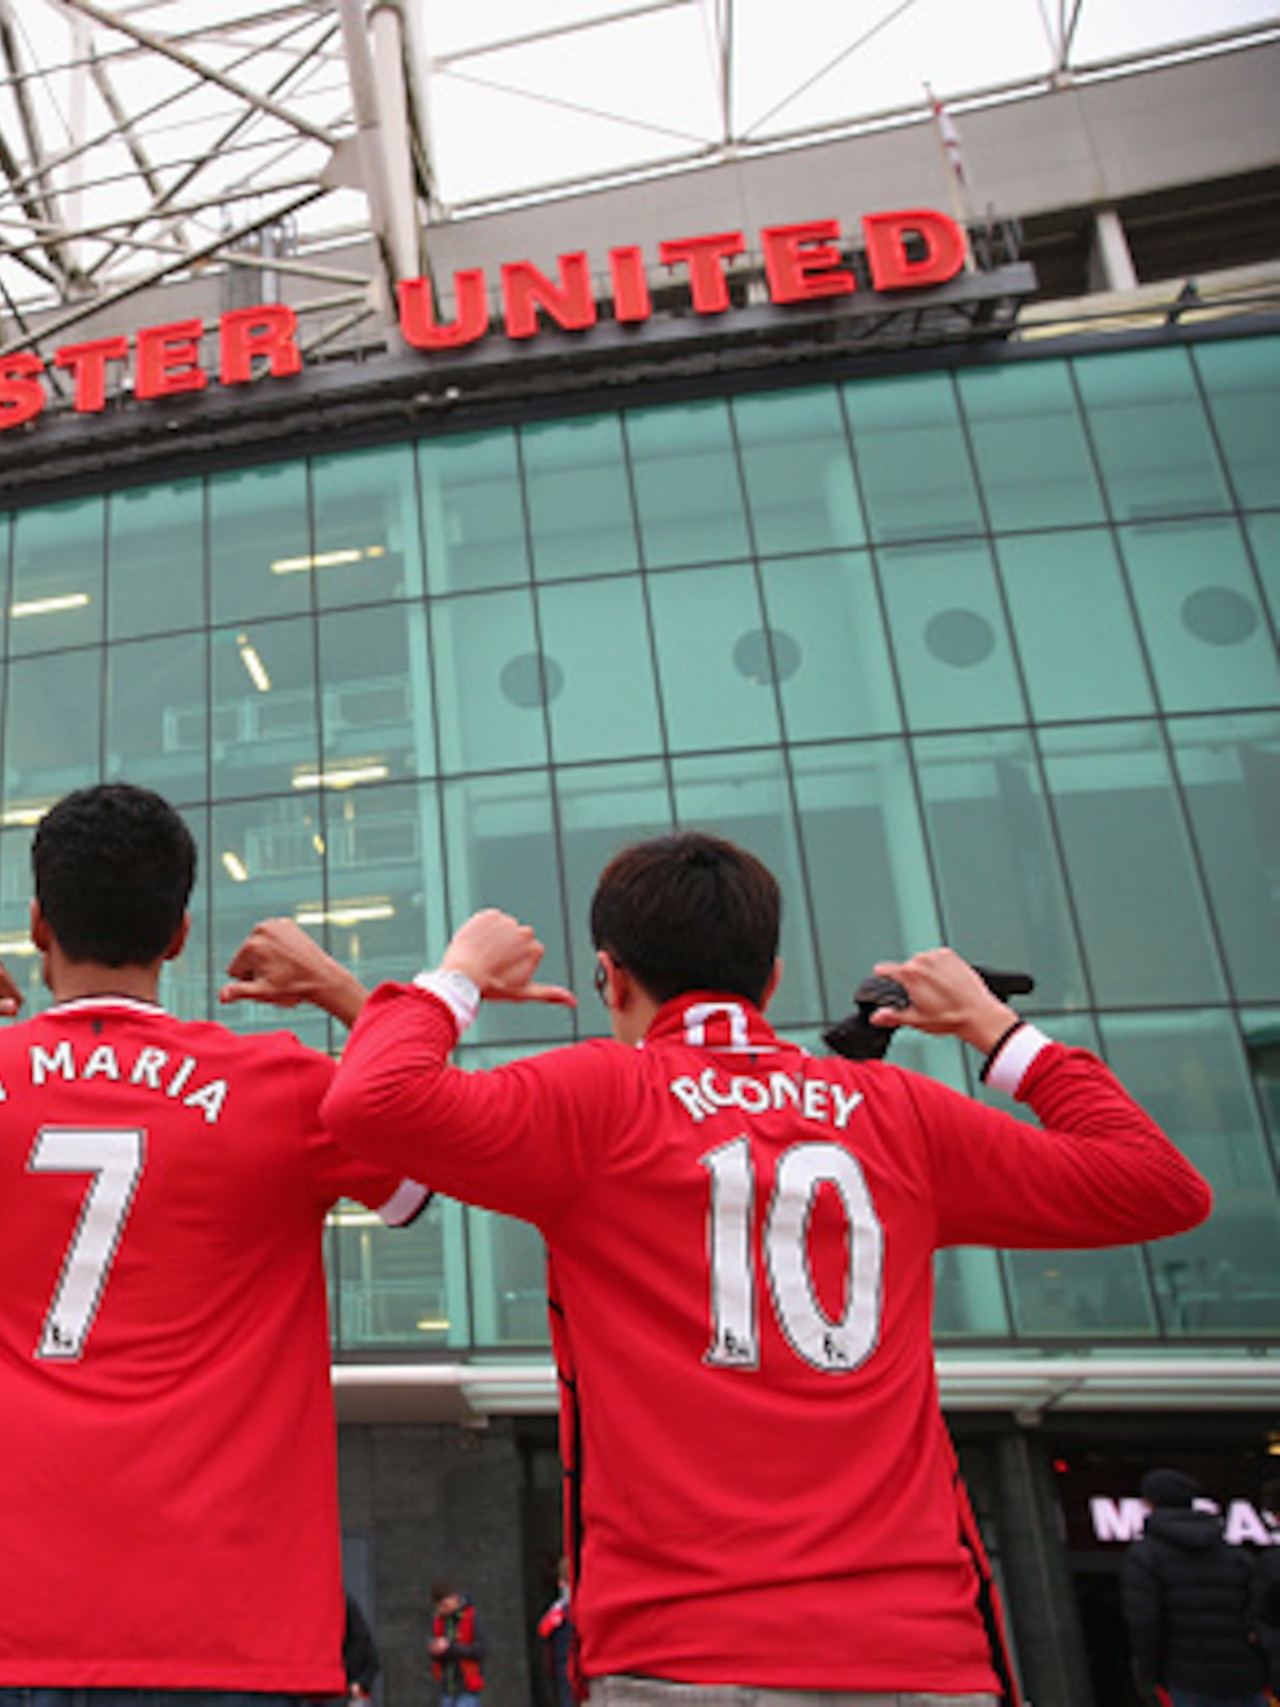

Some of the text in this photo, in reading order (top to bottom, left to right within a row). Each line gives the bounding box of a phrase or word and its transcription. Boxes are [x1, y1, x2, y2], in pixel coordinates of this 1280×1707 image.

[397, 210, 968, 350] UNITED
[30, 1042, 228, 1122] MARIA
[26, 1126, 147, 1360] 7
[700, 1134, 884, 1372] 10
